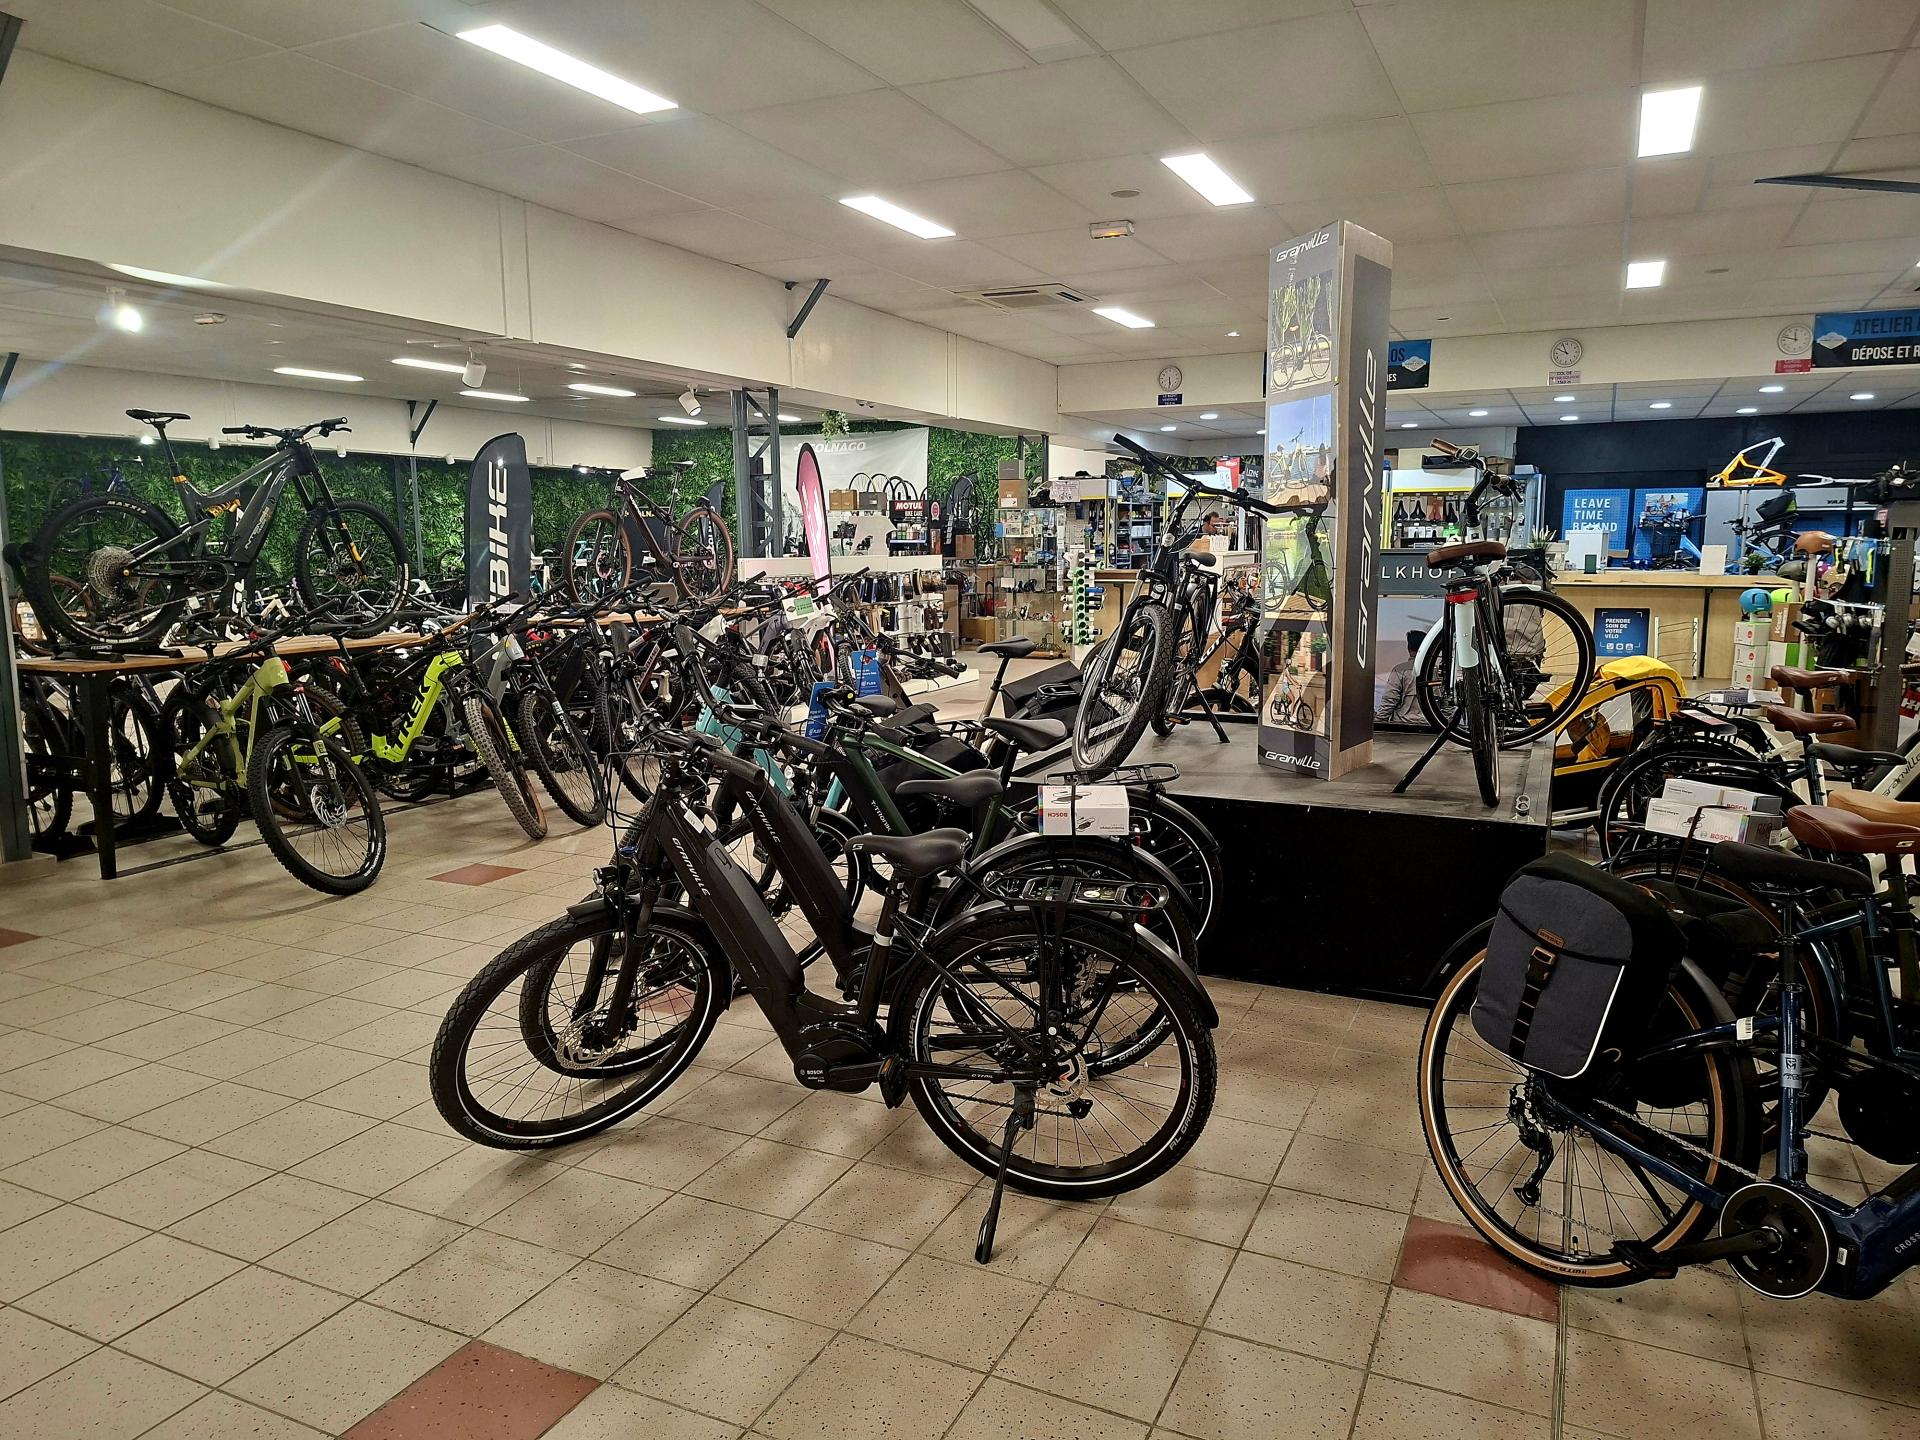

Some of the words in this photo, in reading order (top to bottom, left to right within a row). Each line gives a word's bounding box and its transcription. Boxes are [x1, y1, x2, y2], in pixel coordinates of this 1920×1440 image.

[1852, 316, 1913, 336] ATELIER
[1388, 347, 1405, 363] OS
[1851, 345, 1895, 361] DÉPOSE
[1896, 345, 1911, 359] ET
[895, 502, 923, 510] MOTUL
[1574, 498, 1611, 508] LEAVE
[1574, 510, 1603, 520] TIME
[1572, 522, 1618, 532] BEND
[1381, 566, 1467, 579] LKHOF
[392, 684, 431, 751] TREK
[1710, 832, 1734, 841] BOSCH
[1169, 1136, 1182, 1150] AL
[1180, 1070, 1200, 1135] GROUNDER
[462, 1115, 473, 1126] AL
[474, 1123, 530, 1144] GROUNDER
